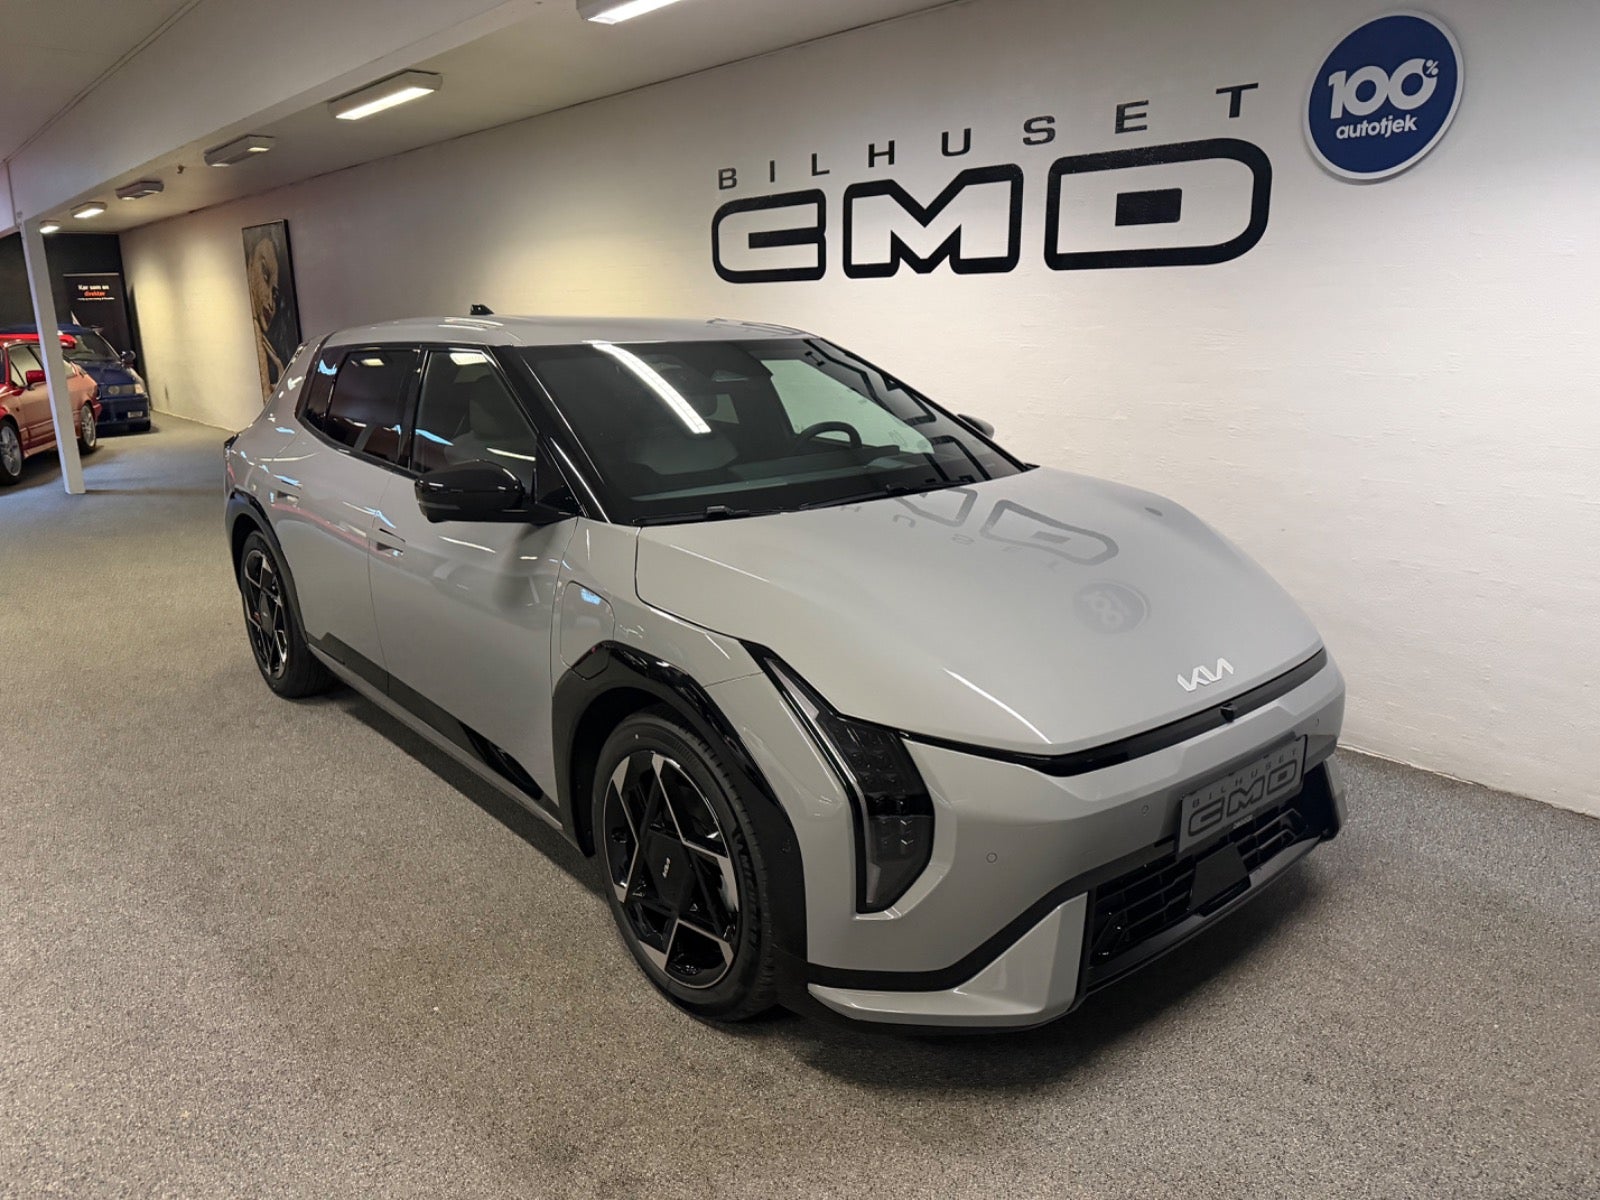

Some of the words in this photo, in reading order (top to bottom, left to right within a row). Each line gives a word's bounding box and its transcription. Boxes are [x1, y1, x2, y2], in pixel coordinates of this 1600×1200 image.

[1328, 58, 1439, 119] 100%
[717, 82, 1259, 190] BILHUSET
[1336, 114, 1418, 139] autotjek
[711, 137, 1272, 283] CMD
[1177, 657, 1234, 692] KIA
[1188, 759, 1297, 837] CMD
[1192, 748, 1296, 808] BILHUSET
